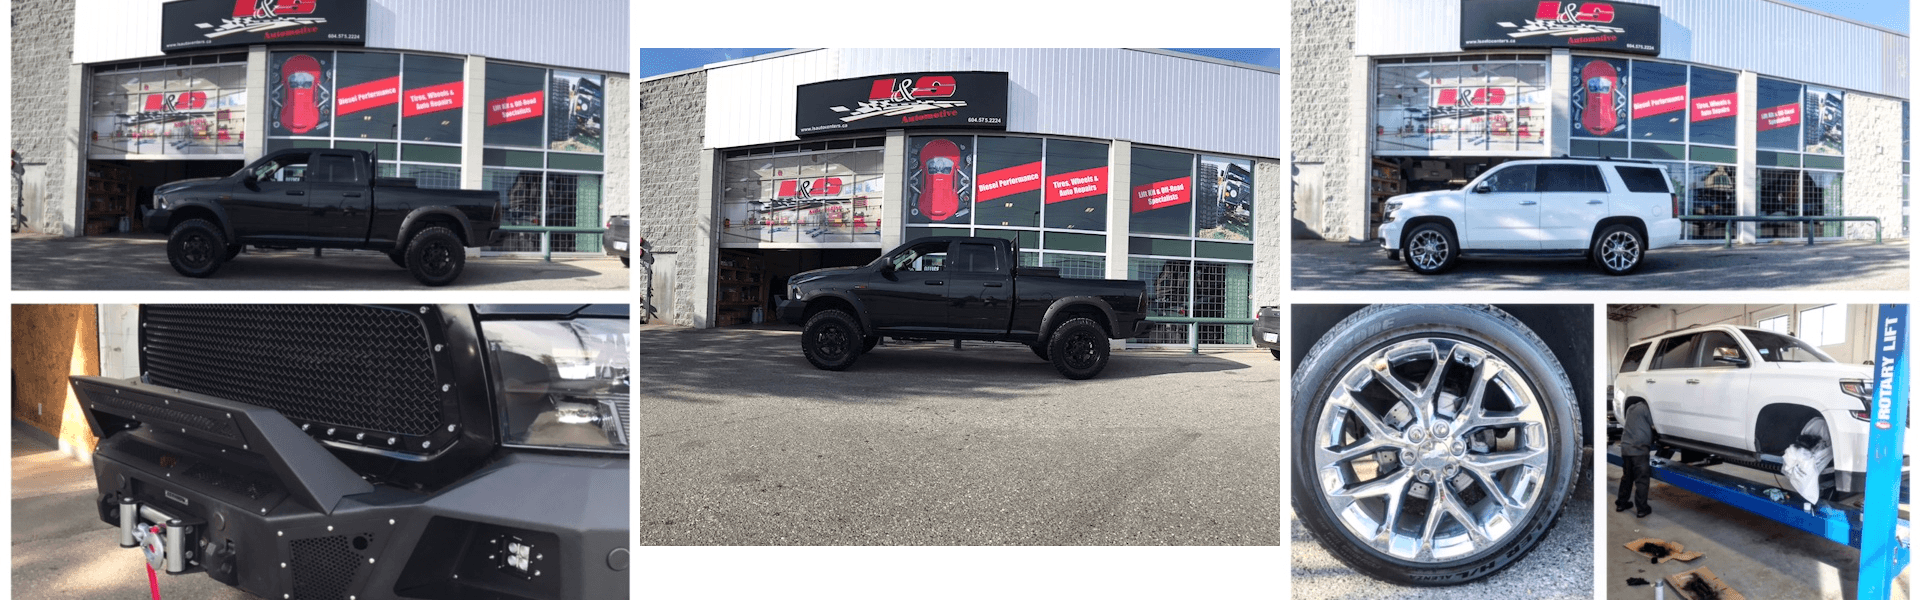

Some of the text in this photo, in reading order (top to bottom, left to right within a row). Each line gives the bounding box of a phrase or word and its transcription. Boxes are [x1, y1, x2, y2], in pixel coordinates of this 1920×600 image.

[264, 26, 319, 40] Automotive
[1568, 34, 1617, 45] Automotive
[338, 87, 397, 106] Diesel Performance
[902, 110, 958, 123] Automotive
[967, 116, 1001, 124] 604.575.2224
[978, 172, 1039, 192] Diesel Performance
[1070, 175, 1094, 187] Wheels
[1059, 184, 1098, 198] Auto Repairs
[1148, 193, 1179, 206] Specialists
[1877, 316, 1899, 421] ROTARY LIFT
